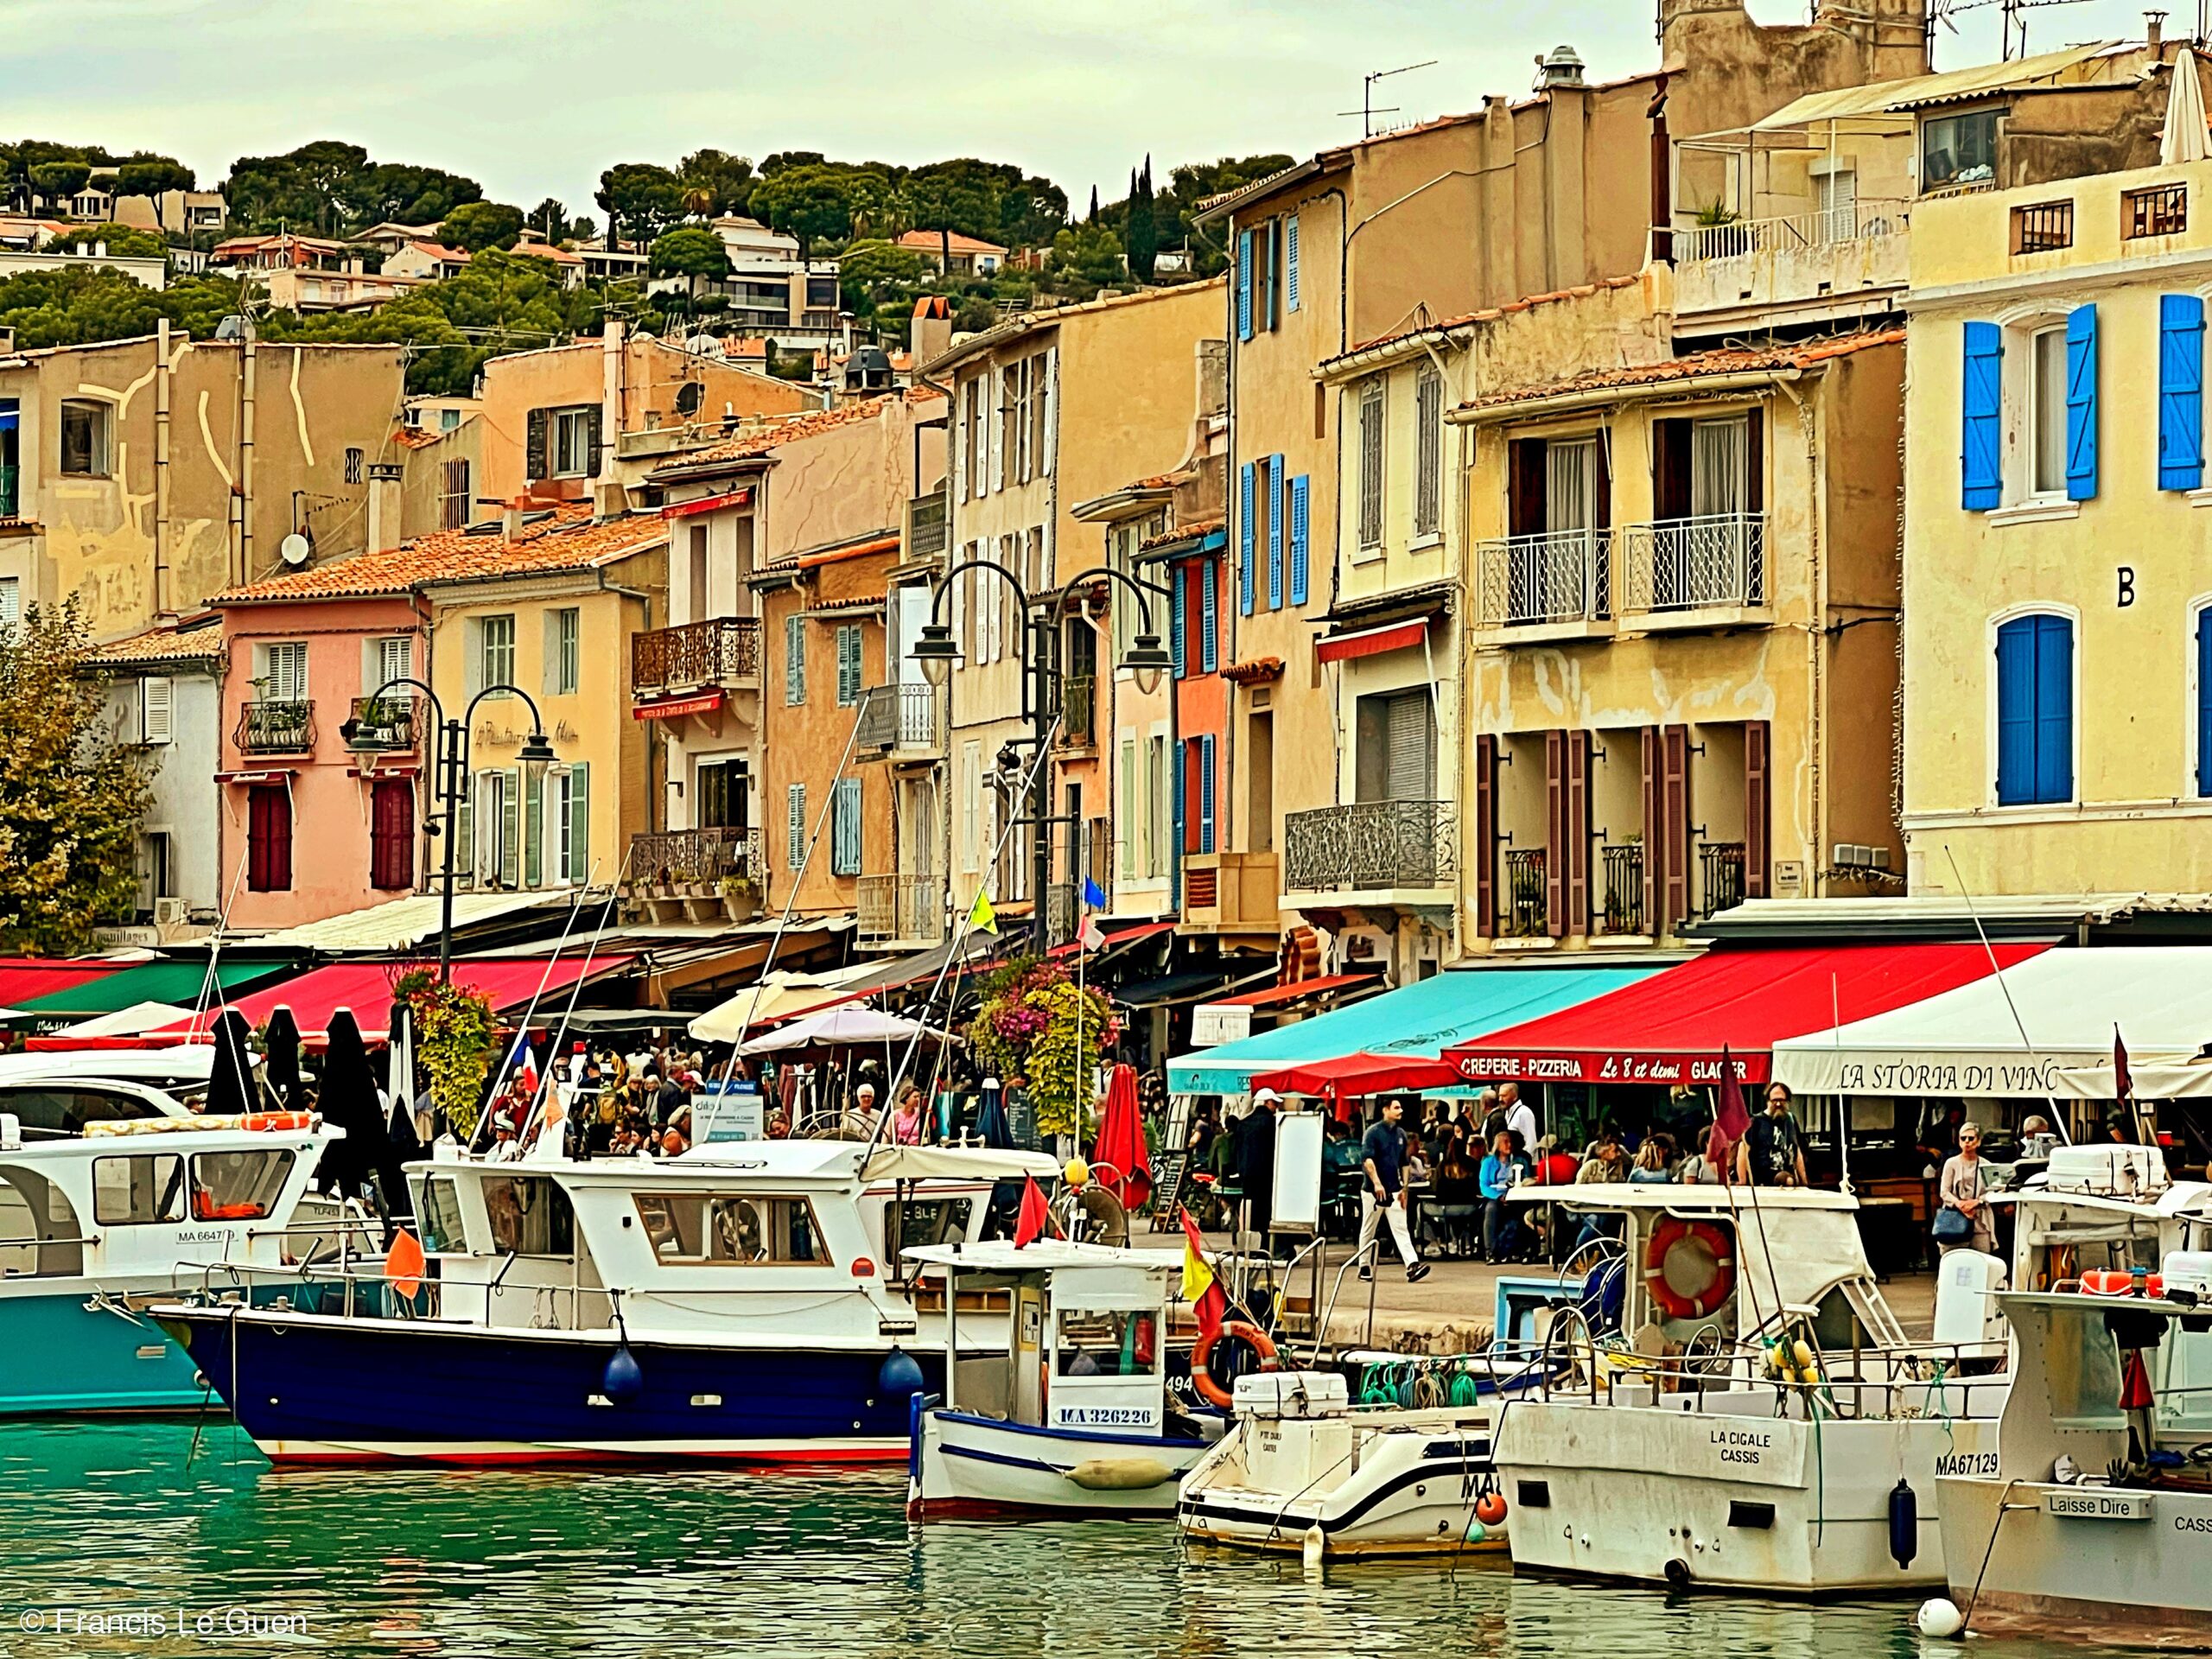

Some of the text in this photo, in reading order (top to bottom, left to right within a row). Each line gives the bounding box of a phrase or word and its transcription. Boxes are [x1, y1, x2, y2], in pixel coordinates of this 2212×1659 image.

[2118, 567, 2135, 607] B
[1460, 1058, 1521, 1076] CREPERIE
[1528, 1058, 1583, 1077] PIZZERIA
[1599, 1056, 1618, 1078] Le
[1623, 1057, 1633, 1078] 8
[1634, 1062, 1648, 1078] et
[1649, 1059, 1681, 1079] demi
[1838, 1065, 1865, 1089] LA
[1872, 1058, 1958, 1090] STORIA
[1964, 1065, 1993, 1090] DI
[178, 1232, 195, 1242] MA
[1090, 1409, 1151, 1424] 326226
[1711, 1430, 1771, 1447] LA CIGALE
[1720, 1449, 1759, 1464] CASSIS
[1936, 1452, 1998, 1475] MA67129
[2049, 1497, 2130, 1516] Laisse Dire
